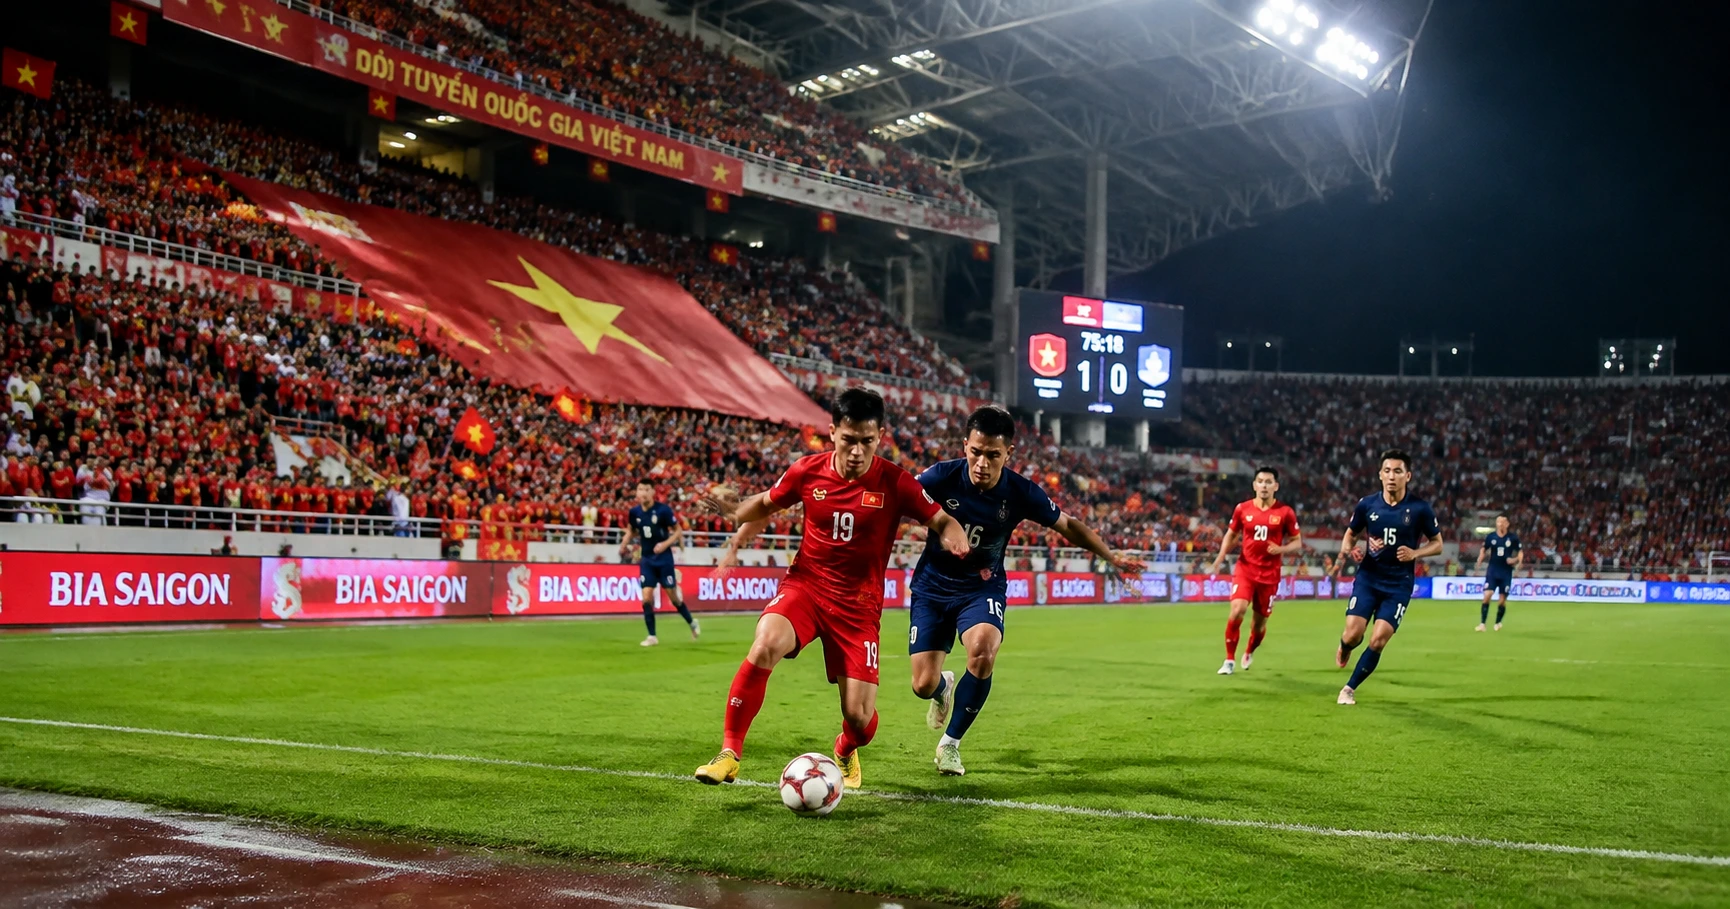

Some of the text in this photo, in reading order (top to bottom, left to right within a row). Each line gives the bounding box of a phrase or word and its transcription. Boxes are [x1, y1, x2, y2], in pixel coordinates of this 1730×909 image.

[549, 112, 584, 142] GIA
[641, 140, 684, 171] NAM
[1081, 331, 1124, 354] 75:18
[1077, 360, 1091, 392] 1
[1110, 363, 1128, 395] 0
[832, 511, 855, 541] 19
[1253, 525, 1268, 541] 20
[1383, 527, 1397, 545] 15
[49, 572, 231, 606] BIA SAIGON
[335, 575, 467, 604] BIA SAIGON
[539, 576, 643, 602] BIA SAIGON
[698, 577, 779, 600] BIA SAIGON
